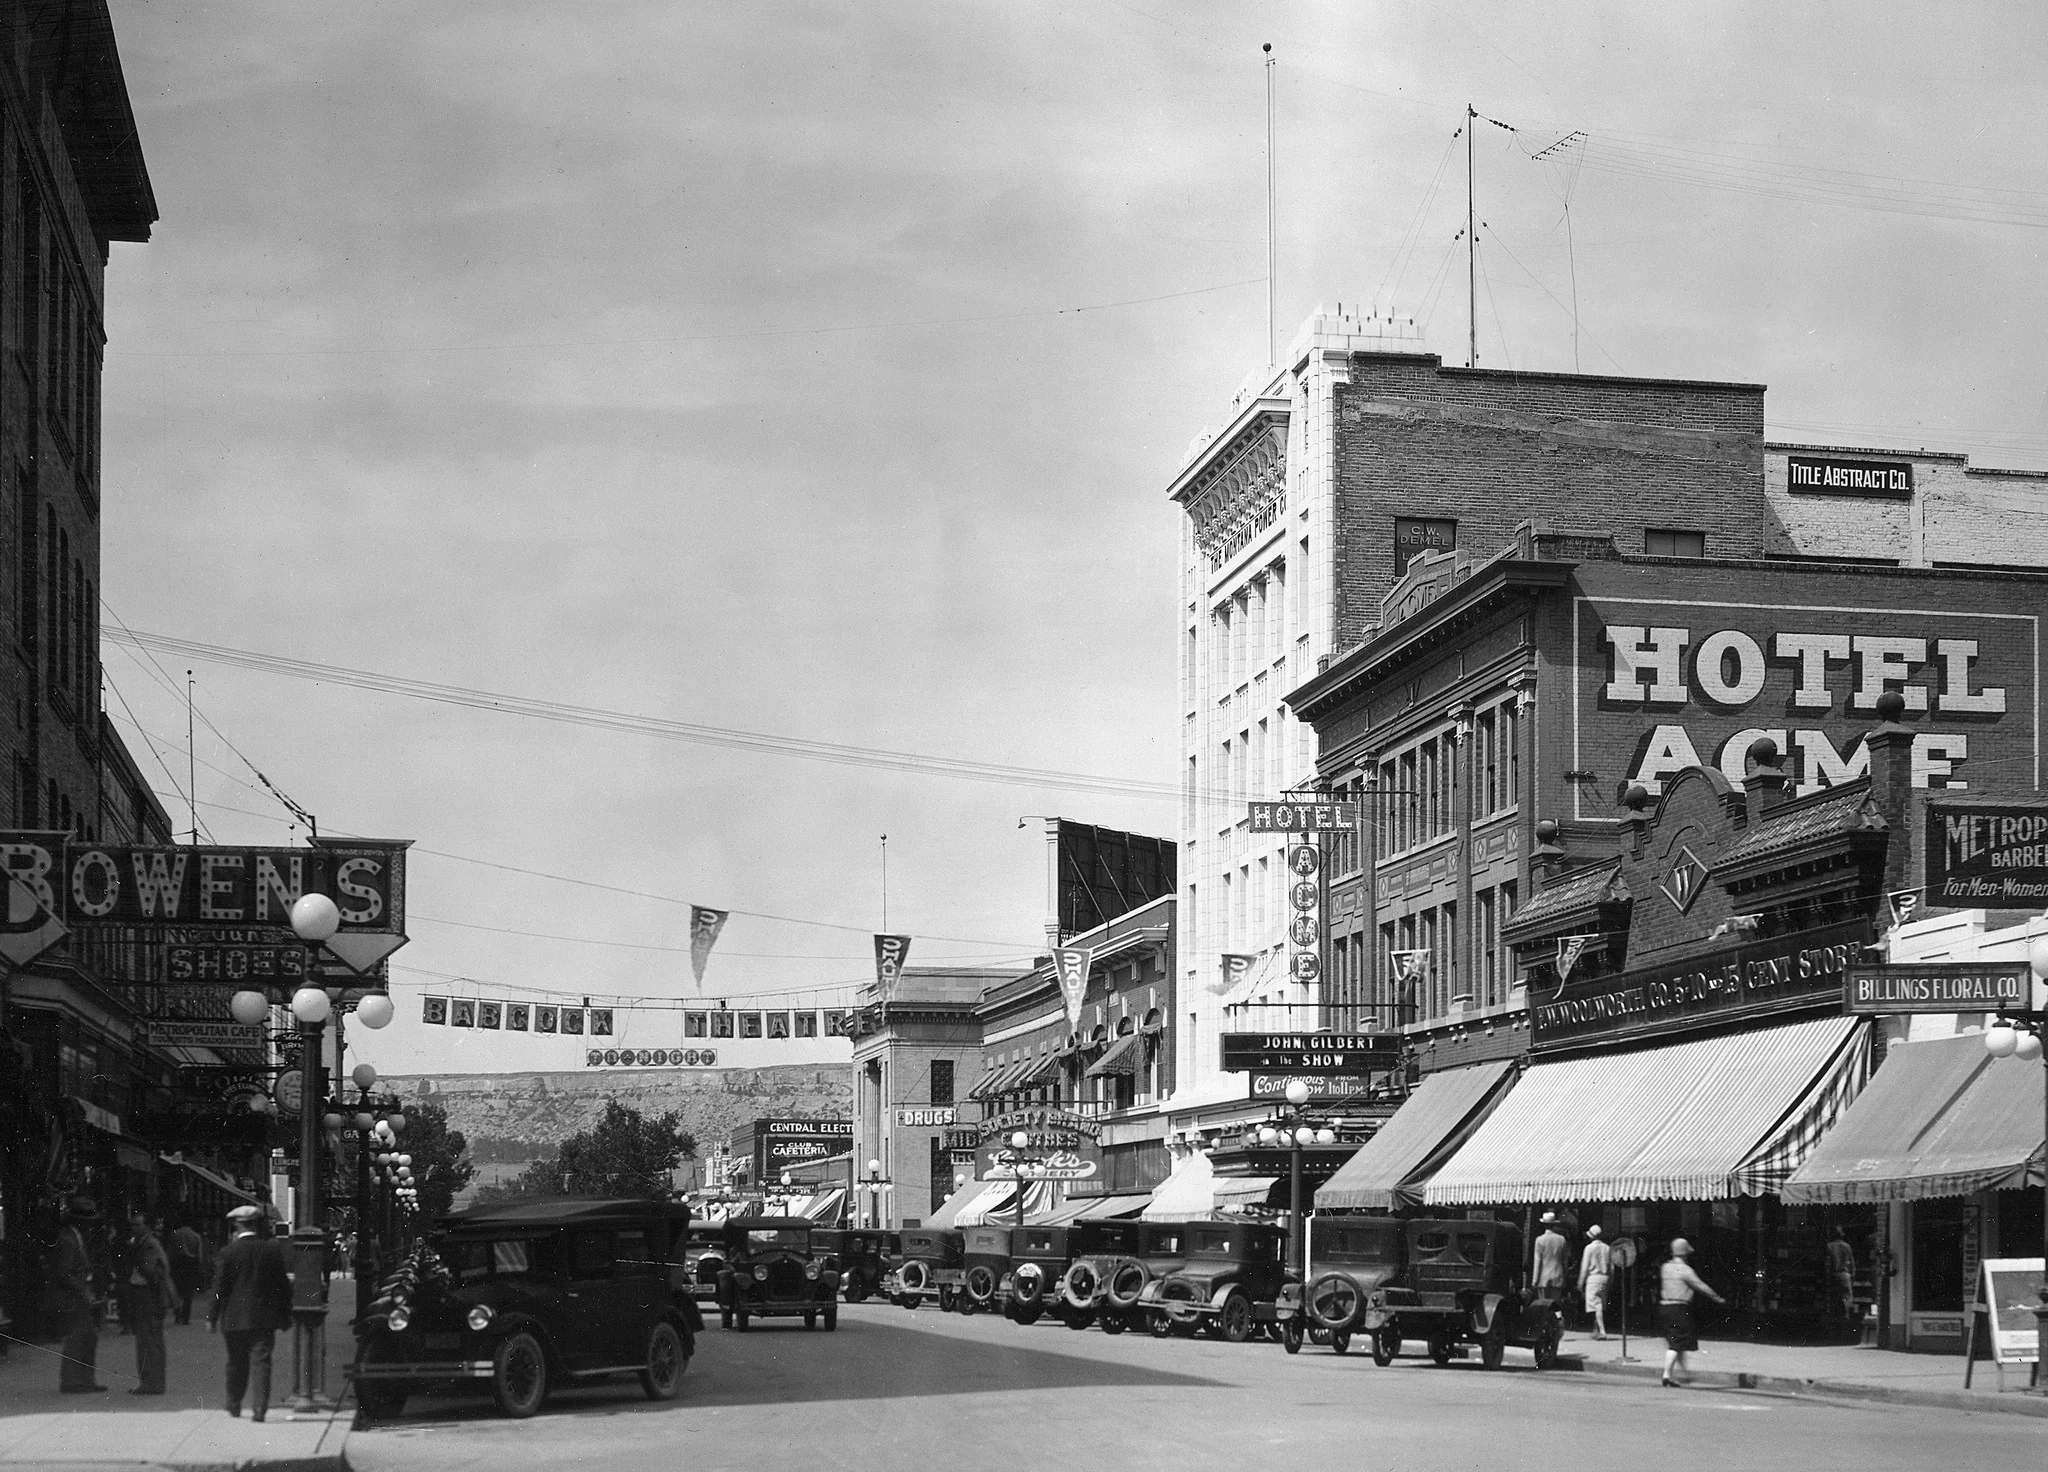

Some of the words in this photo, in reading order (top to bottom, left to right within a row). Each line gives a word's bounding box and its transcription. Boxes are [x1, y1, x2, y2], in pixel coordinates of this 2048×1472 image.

[1790, 463, 1822, 485] TITLE
[1823, 465, 1887, 489] ABSTRACT
[1400, 535, 1449, 546] DEMEL
[1605, 624, 2006, 714] HOTEL
[1628, 724, 1968, 797] ACME
[1253, 804, 1353, 829] HOTEL
[1991, 843, 2048, 867] BARBE
[1942, 877, 1968, 897] For
[1295, 848, 1316, 979] ACME
[171, 949, 301, 979] SHOES
[1747, 955, 1791, 989] CENT
[1799, 940, 1862, 979] STORE
[1858, 978, 1930, 1001] BILLINGS
[1933, 977, 1996, 999] FLORAL
[1996, 976, 2020, 999] CO.
[150, 1022, 229, 1038] METROPOLITAN
[230, 1026, 260, 1038] CAFE
[426, 1000, 612, 1035] BABCOCK
[687, 1012, 874, 1038] THEATRE
[1262, 1036, 1304, 1049] JOHN
[1310, 1036, 1375, 1049] GILBERT
[1302, 1054, 1344, 1067] SHOW
[770, 1122, 816, 1133] CENTRAL
[905, 1111, 953, 1126] DRUGS
[980, 1109, 1044, 1138] SOCIETY
[714, 1141, 722, 1186] HOTEL
[772, 1146, 828, 1156] CAFETERIA
